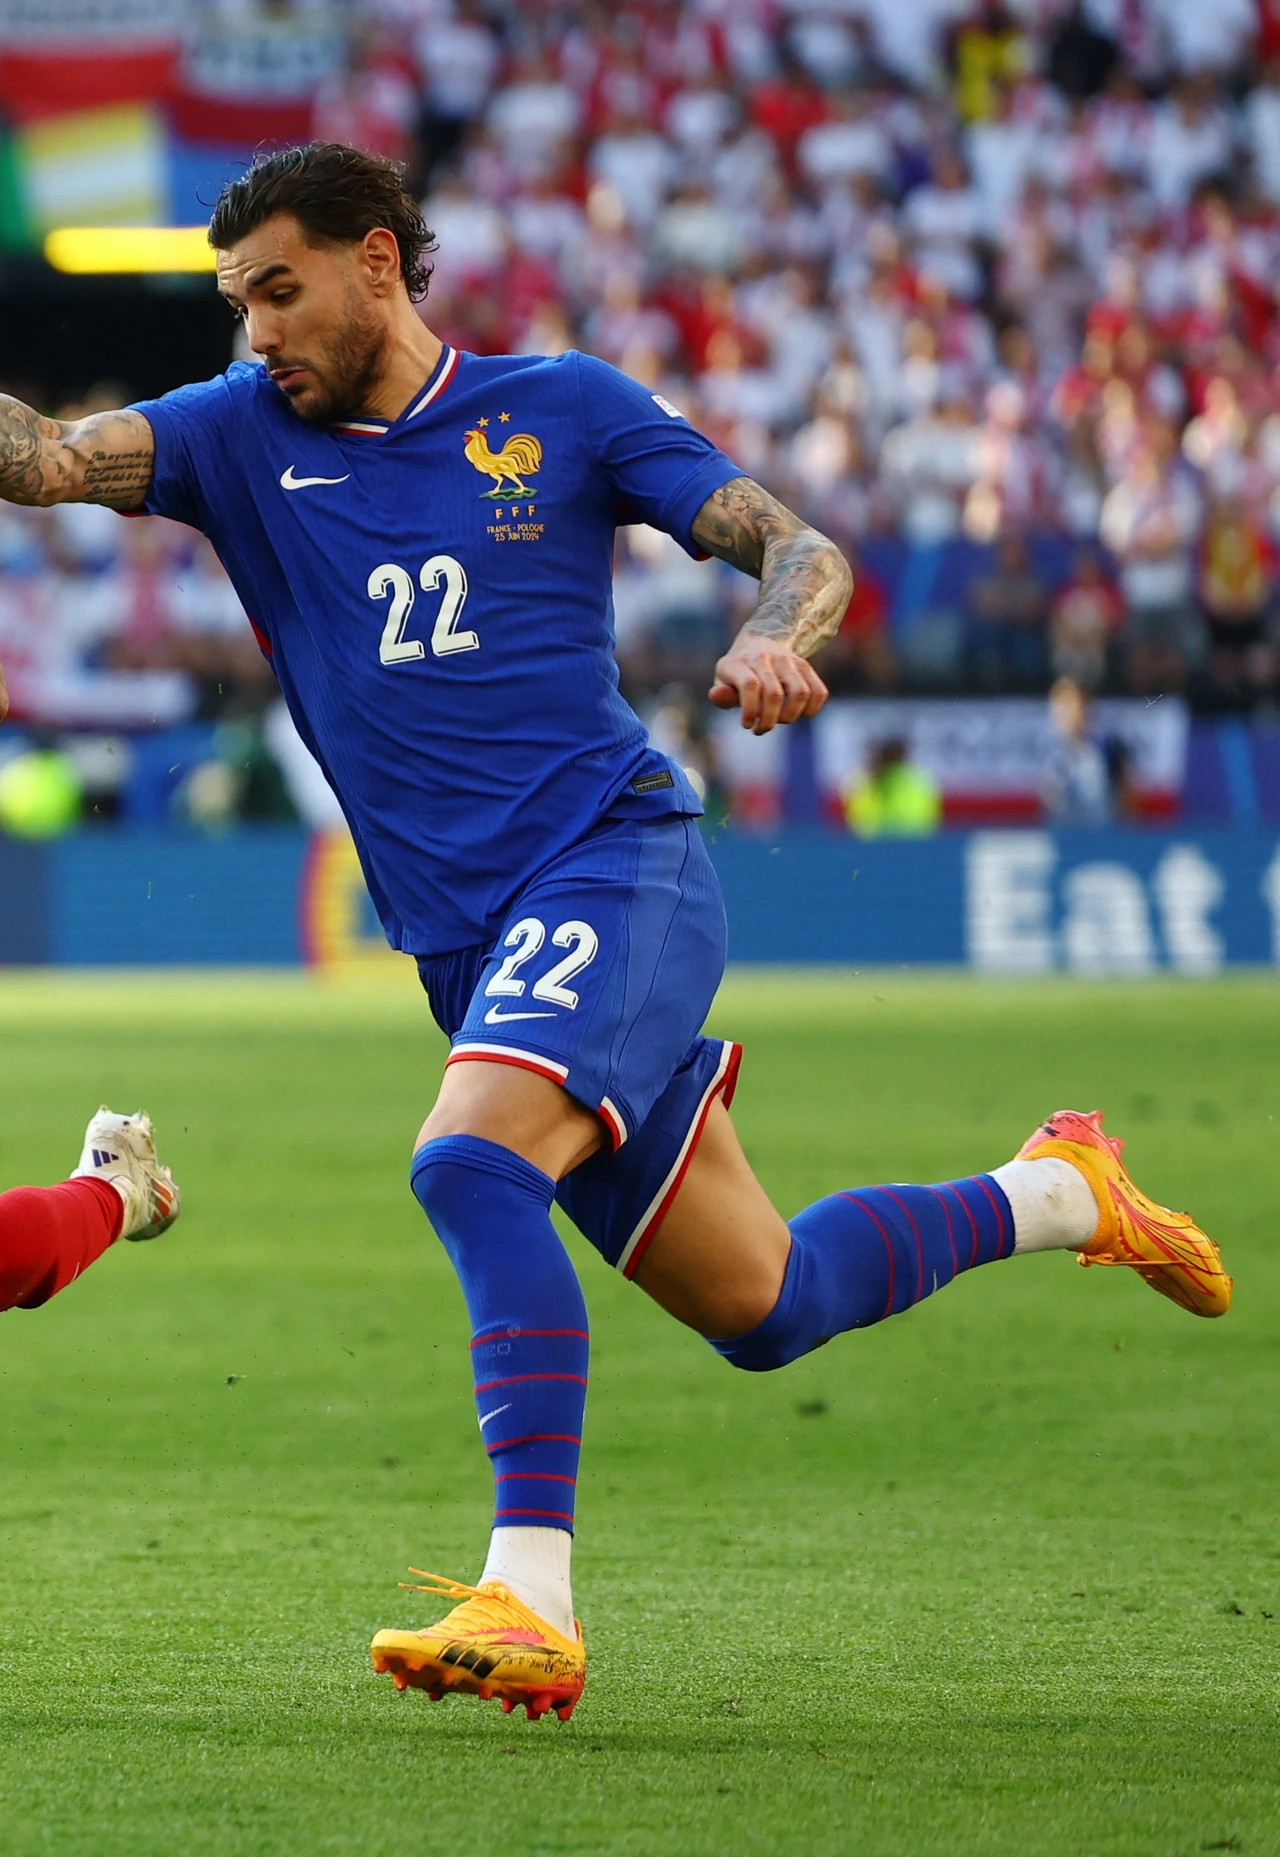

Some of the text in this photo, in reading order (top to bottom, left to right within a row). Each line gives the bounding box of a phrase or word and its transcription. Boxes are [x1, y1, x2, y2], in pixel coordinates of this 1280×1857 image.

[487, 525, 511, 533] FRANCE
[517, 524, 544, 532] POLOGNE
[495, 533, 505, 541] 25
[522, 531, 539, 540] 2024
[367, 554, 480, 666] 22
[966, 831, 1224, 973] Eat
[484, 917, 599, 1011] 22
